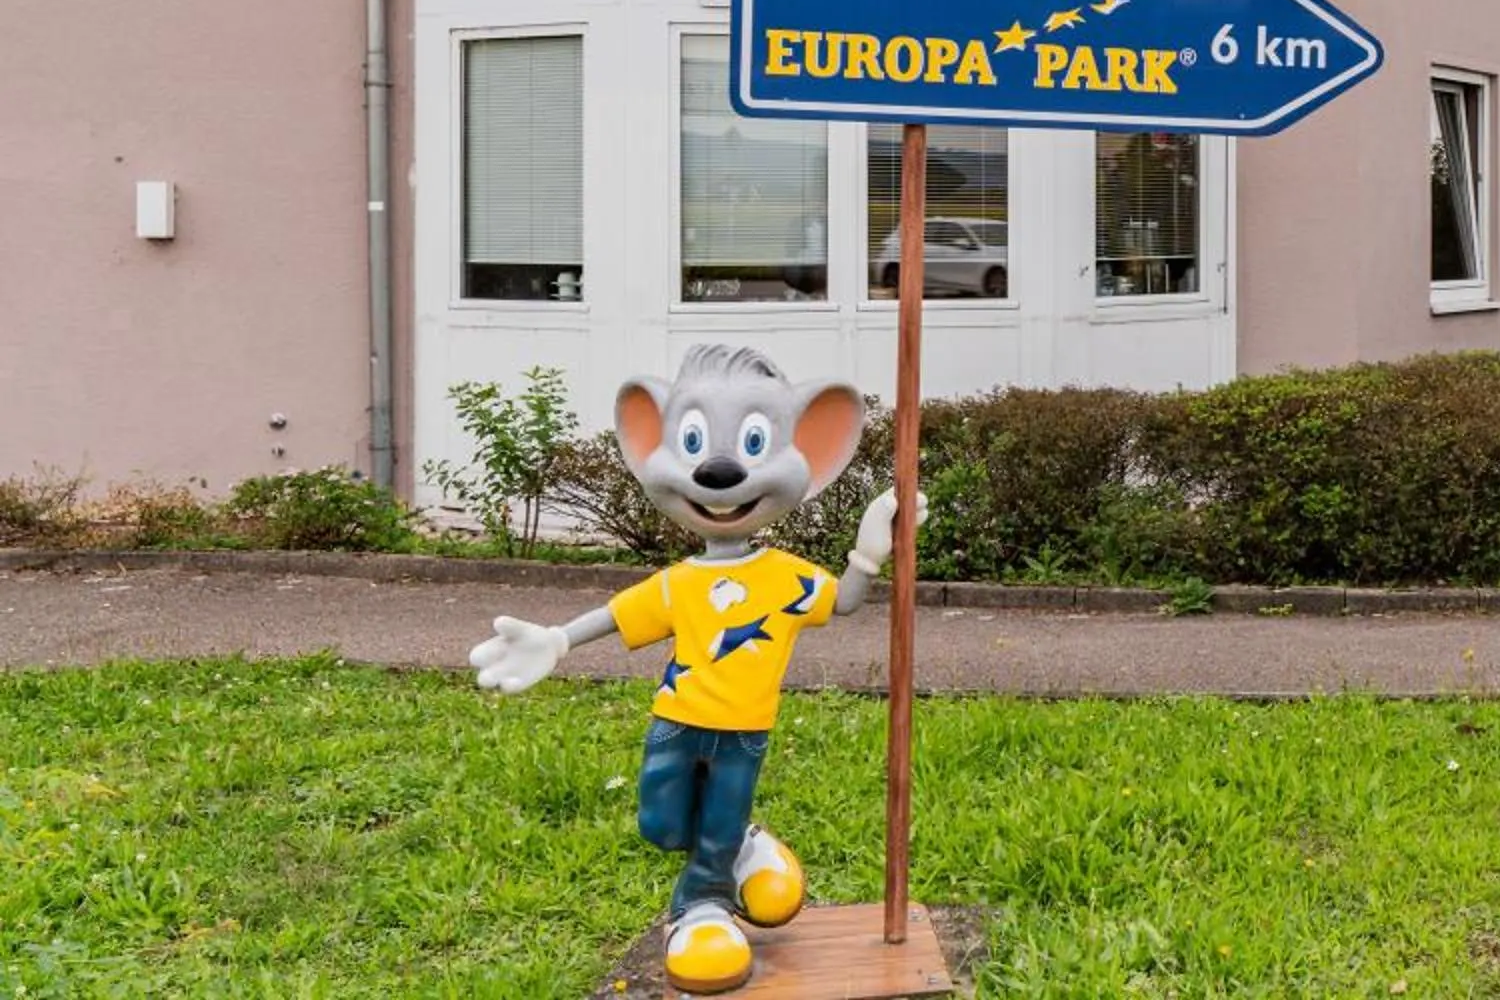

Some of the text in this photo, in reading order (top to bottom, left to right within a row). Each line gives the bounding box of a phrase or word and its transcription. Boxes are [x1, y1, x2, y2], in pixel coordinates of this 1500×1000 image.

[765, 29, 998, 85] EUROPA
[1211, 23, 1239, 65] 6
[1256, 25, 1327, 69] km
